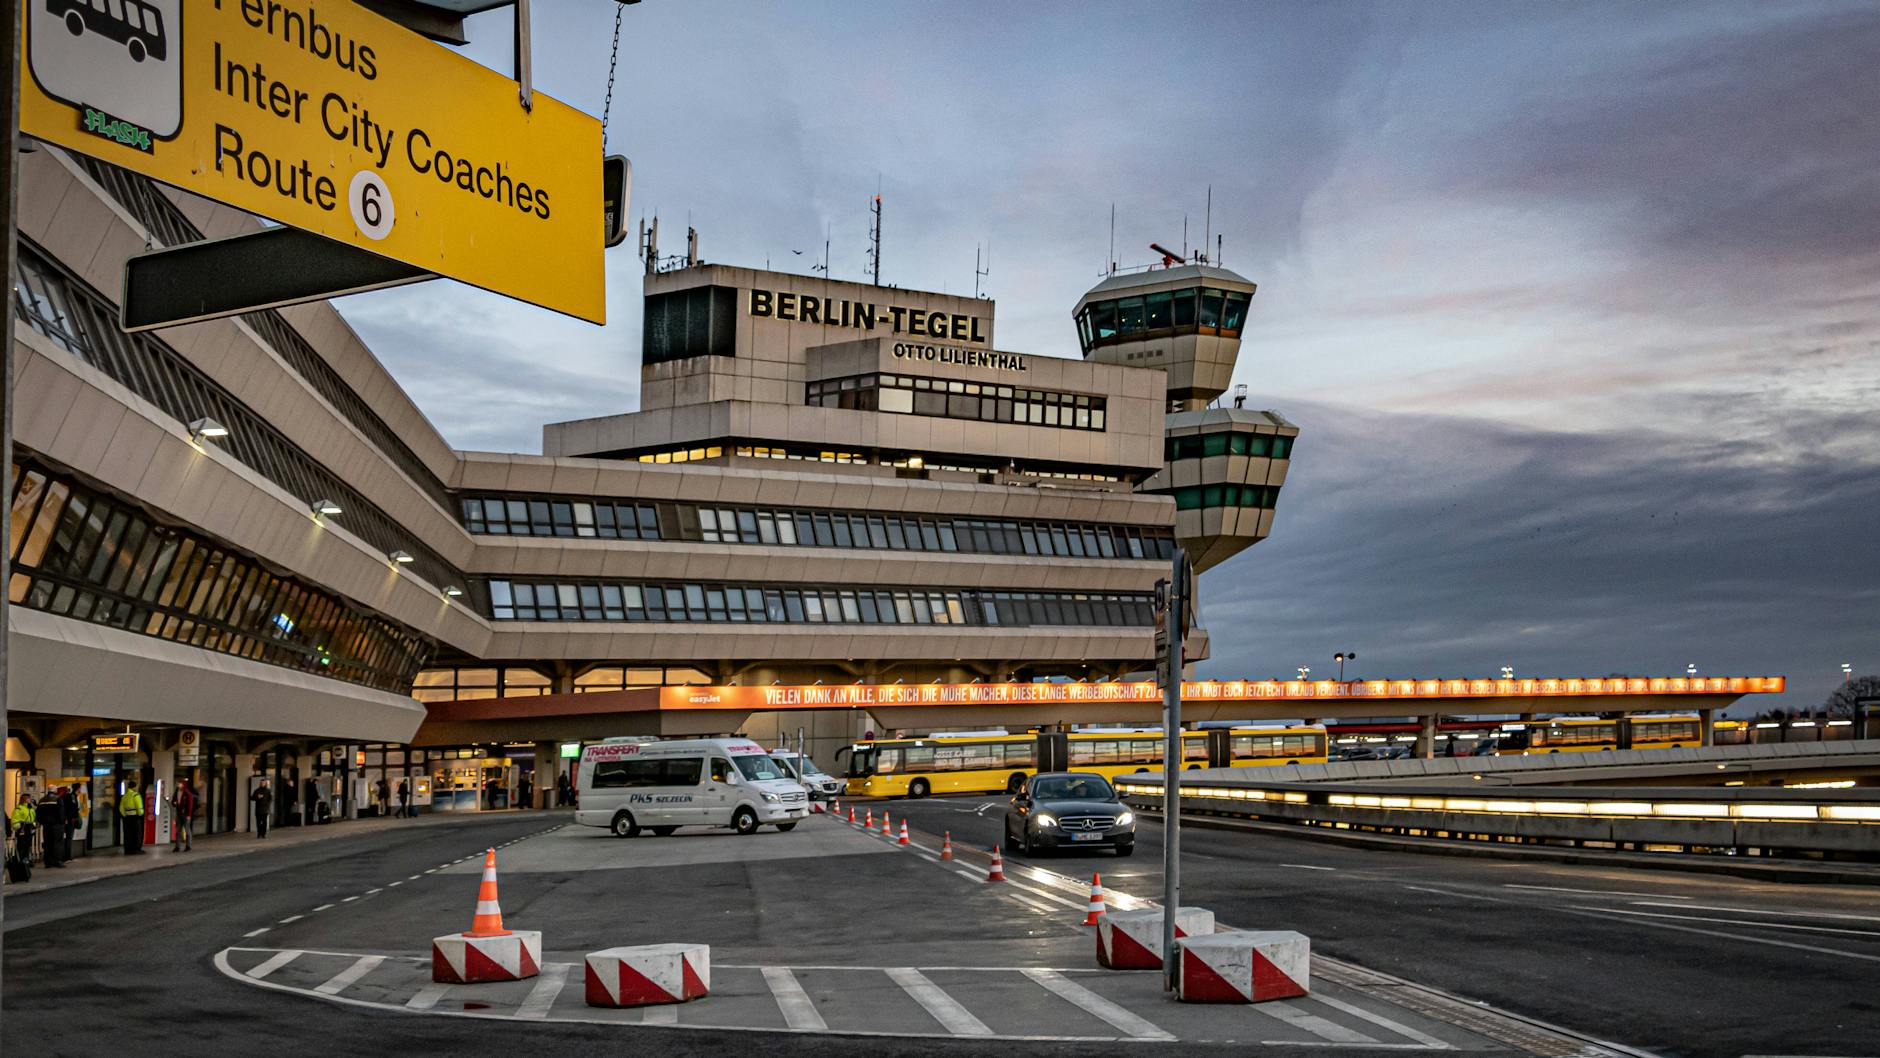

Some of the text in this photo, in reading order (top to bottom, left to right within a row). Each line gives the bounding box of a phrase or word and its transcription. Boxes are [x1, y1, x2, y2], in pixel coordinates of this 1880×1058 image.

[214, 0, 377, 81] ernbus
[214, 41, 551, 220] Inter City Coaches
[215, 123, 382, 228] Route 6
[750, 288, 985, 343] BERLIN-TEGEL
[894, 343, 1027, 371] OTTO LILIENTHAL
[766, 688, 801, 705] VIELEN
[804, 688, 831, 704] DANK
[833, 688, 847, 703] AN
[850, 687, 876, 704] ALLE,
[879, 687, 894, 703] DIE
[897, 687, 919, 702] SICH
[922, 687, 937, 702] DIE
[970, 686, 1009, 703] MACHEN,
[1012, 686, 1036, 701] DIESE
[1039, 686, 1066, 700] LANGE
[1069, 685, 1145, 700] WERBEBOTSCHAFT
[1145, 685, 1156, 699] ZU
[1187, 684, 1200, 698] IHR
[1202, 684, 1222, 698] HABT
[1245, 684, 1265, 697] JETZT
[630, 793, 693, 804] PKS SZCZECIN
